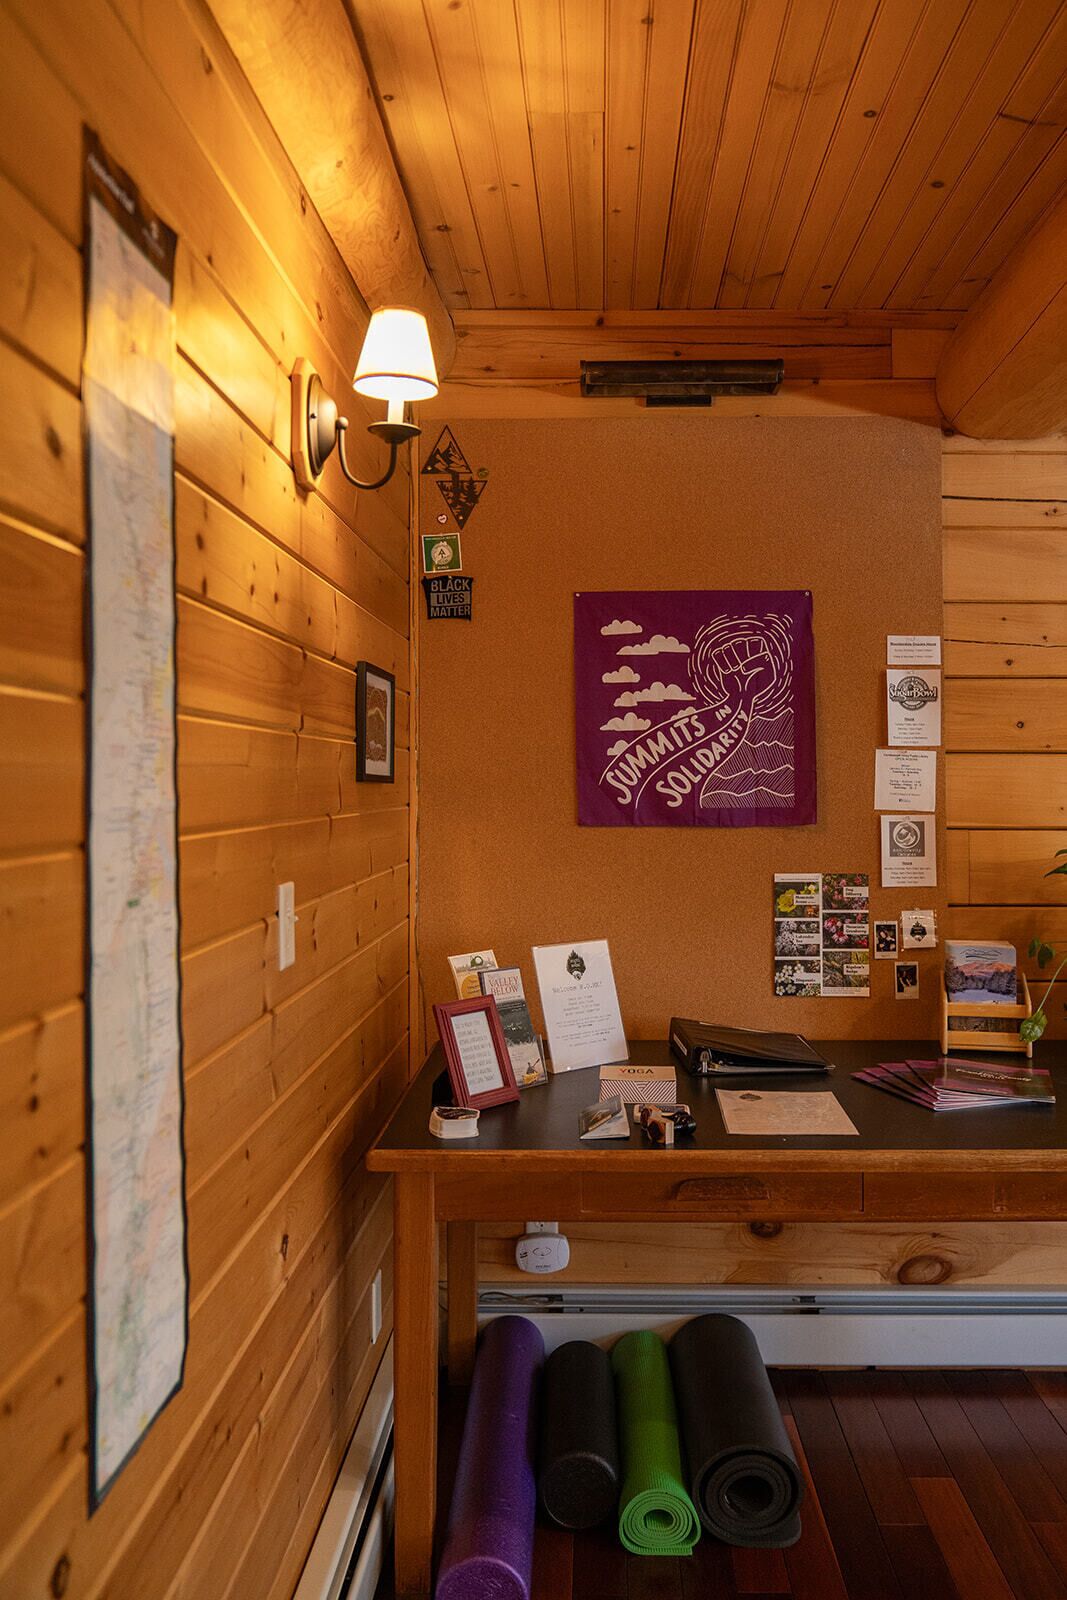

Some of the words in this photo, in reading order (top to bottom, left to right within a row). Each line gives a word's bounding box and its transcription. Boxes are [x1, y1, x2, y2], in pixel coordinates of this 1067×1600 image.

[431, 578, 470, 592] BLACK
[436, 592, 465, 605] LIVES
[430, 605, 471, 617] MATTER
[606, 715, 706, 805] SUMMITS
[715, 704, 733, 722] IN
[656, 709, 749, 808] SOLIDARITY
[489, 975, 519, 987] VALLEY
[490, 985, 519, 996] BELOW
